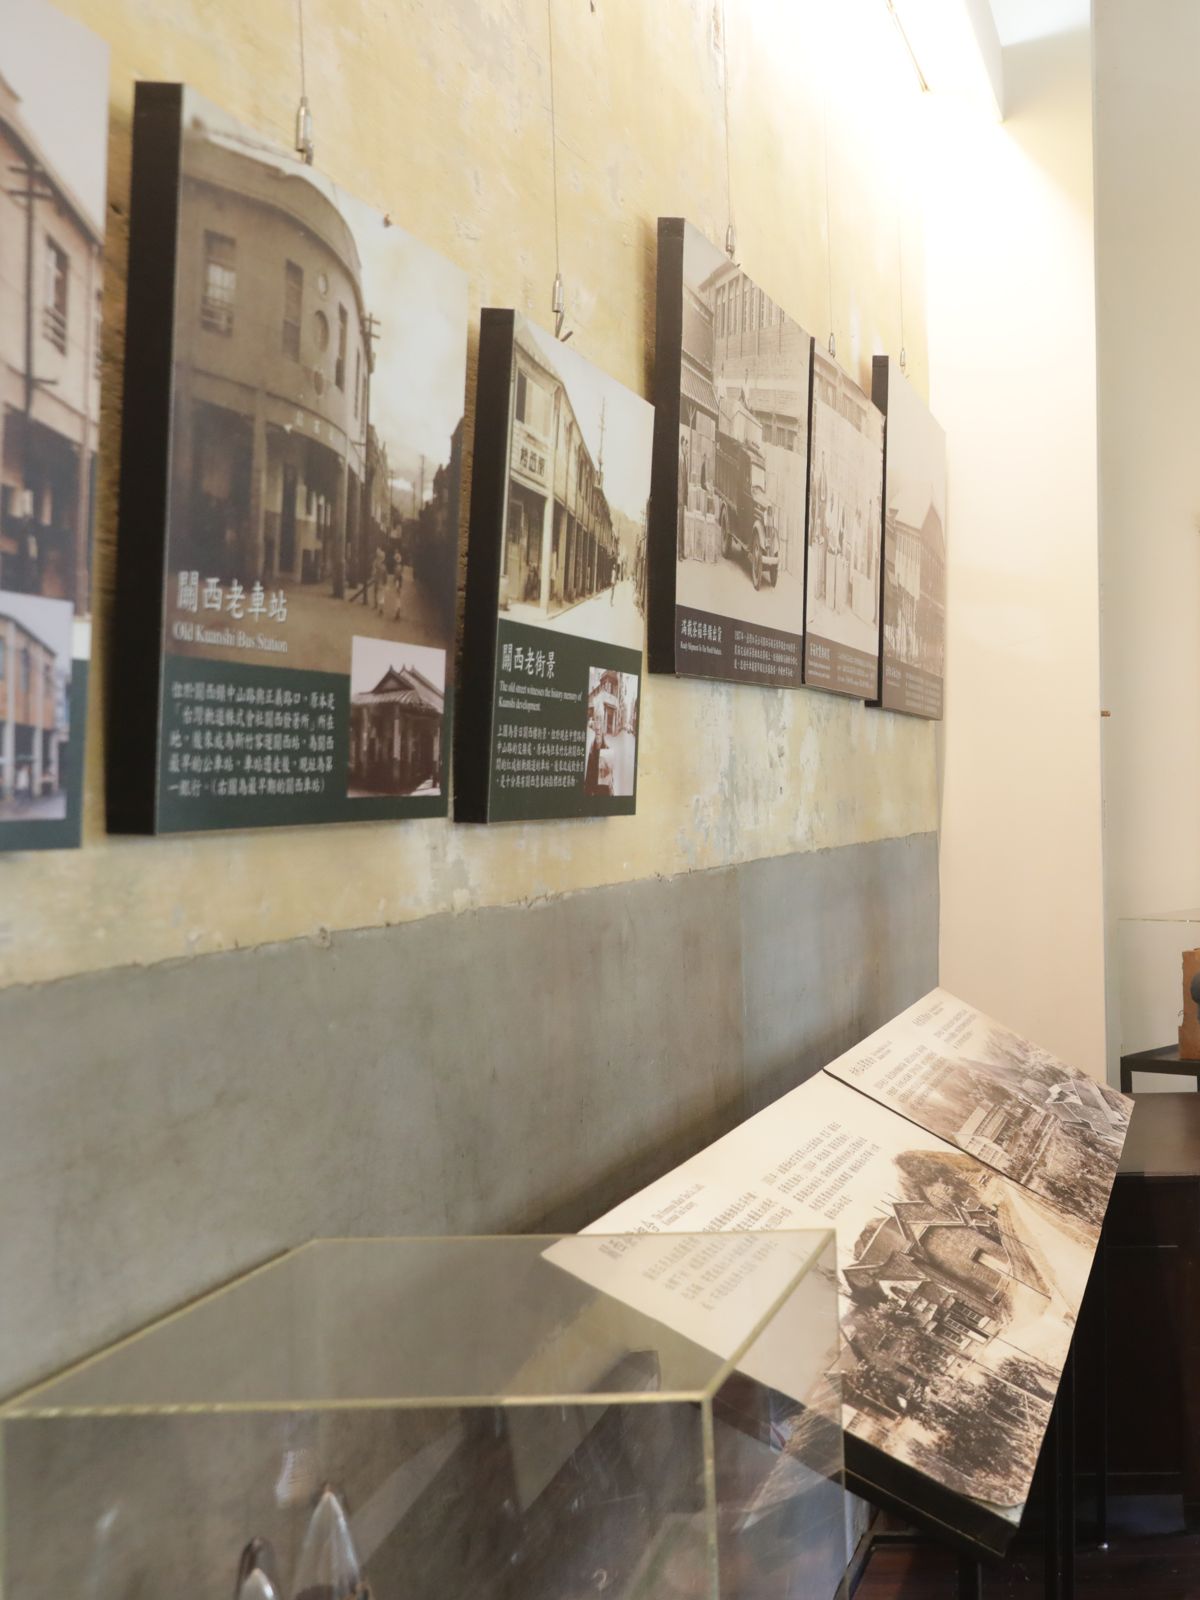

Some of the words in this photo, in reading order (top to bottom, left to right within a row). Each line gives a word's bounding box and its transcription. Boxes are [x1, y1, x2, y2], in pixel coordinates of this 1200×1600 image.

[176, 569, 288, 624] 關西老車站
[172, 621, 193, 641] Old
[238, 629, 255, 649] Bus
[256, 632, 288, 653] Station
[501, 643, 556, 679] 關西老街景
[499, 680, 507, 692] The
[577, 691, 583, 702] of
